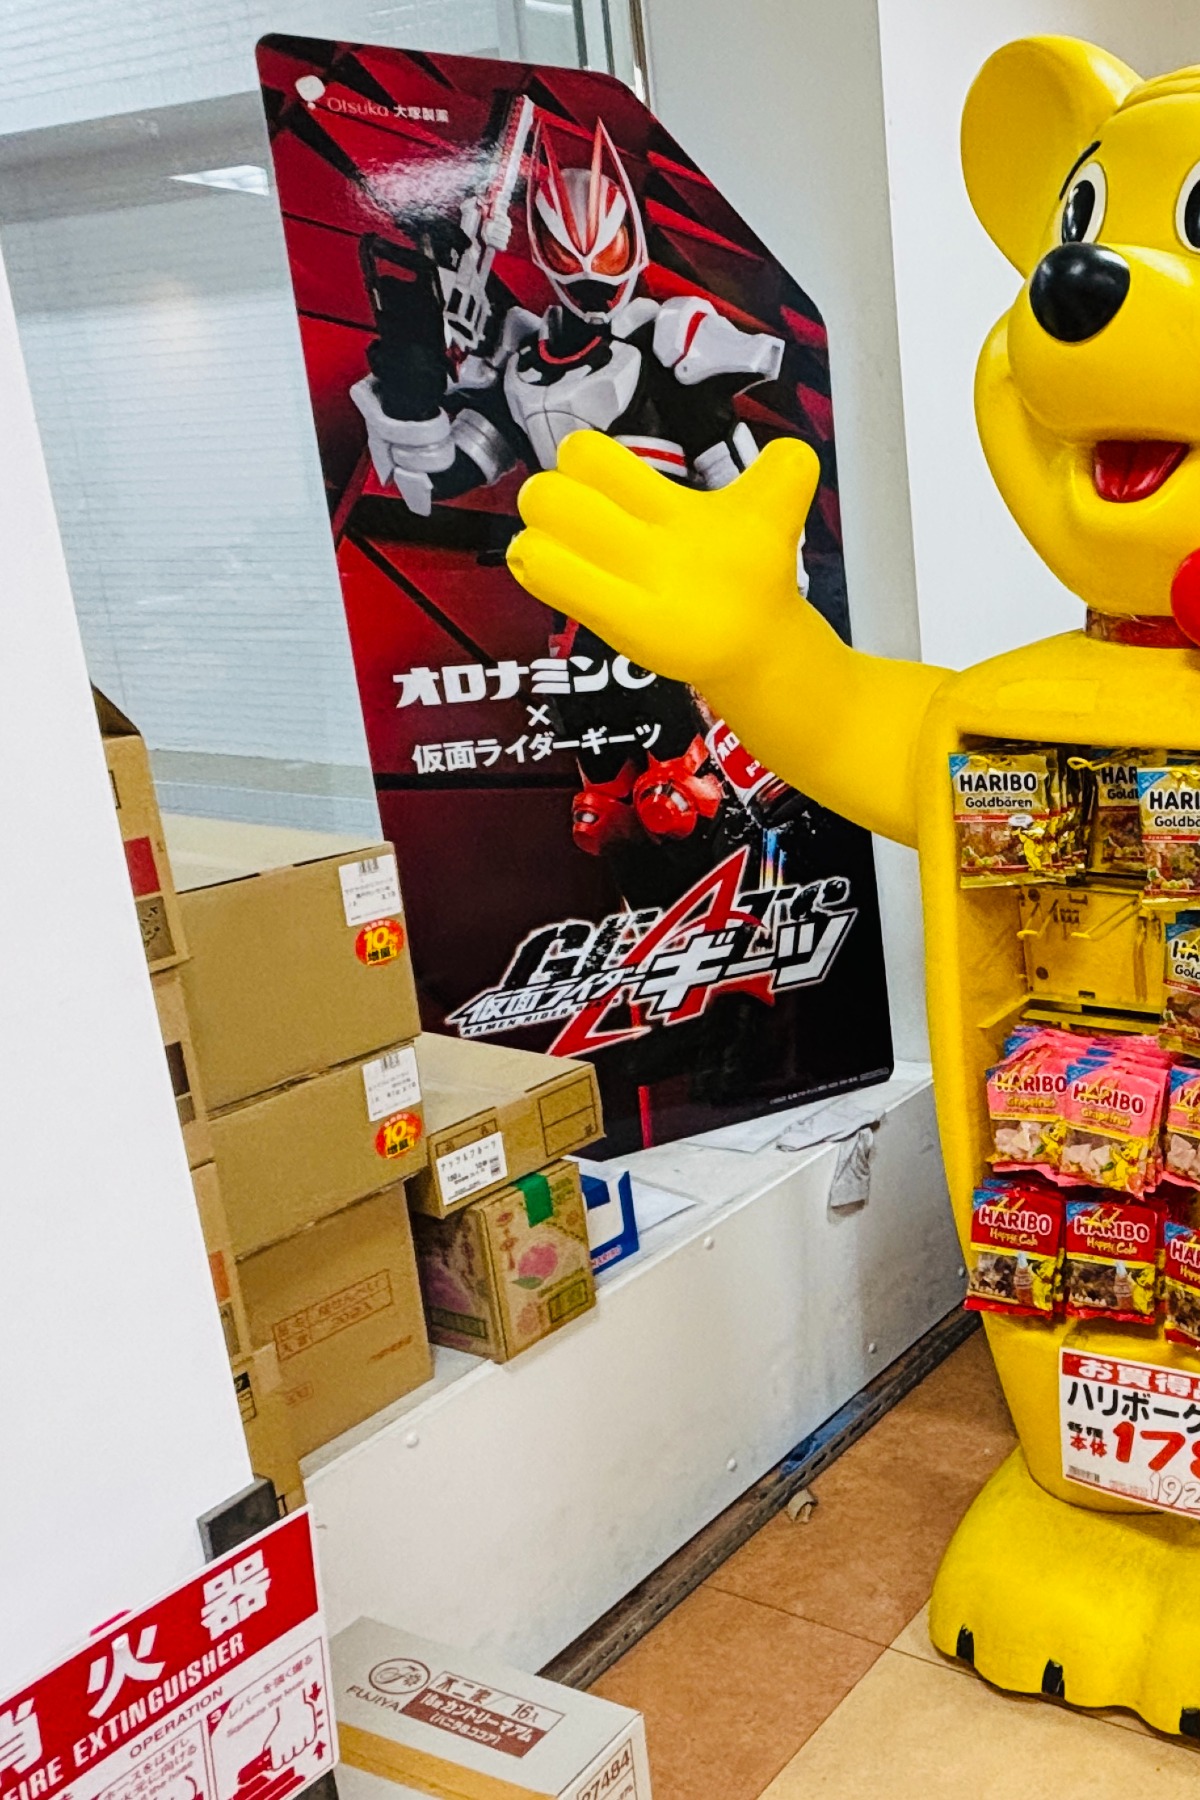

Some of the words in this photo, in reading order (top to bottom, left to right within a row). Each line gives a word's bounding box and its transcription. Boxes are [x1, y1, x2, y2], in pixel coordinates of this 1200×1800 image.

[326, 97, 389, 117] Otsuka
[412, 722, 662, 774] 仮面ライダーギーツ
[959, 773, 1037, 792] HARIBO
[1102, 766, 1138, 785] HAR
[965, 796, 1033, 808] Goldbären
[464, 1019, 516, 1036] KAMEN
[523, 1008, 569, 1024] RIDER
[1073, 1082, 1144, 1114] HARIBO
[978, 1204, 1053, 1236] HARIBO
[1074, 1215, 1150, 1243] HARIBO
[73, 1632, 246, 1768] EXTINGUISHER
[346, 1684, 401, 1713] FUJIYA
[436, 1676, 492, 1705] 不二家
[129, 1686, 224, 1759] OPERATION
